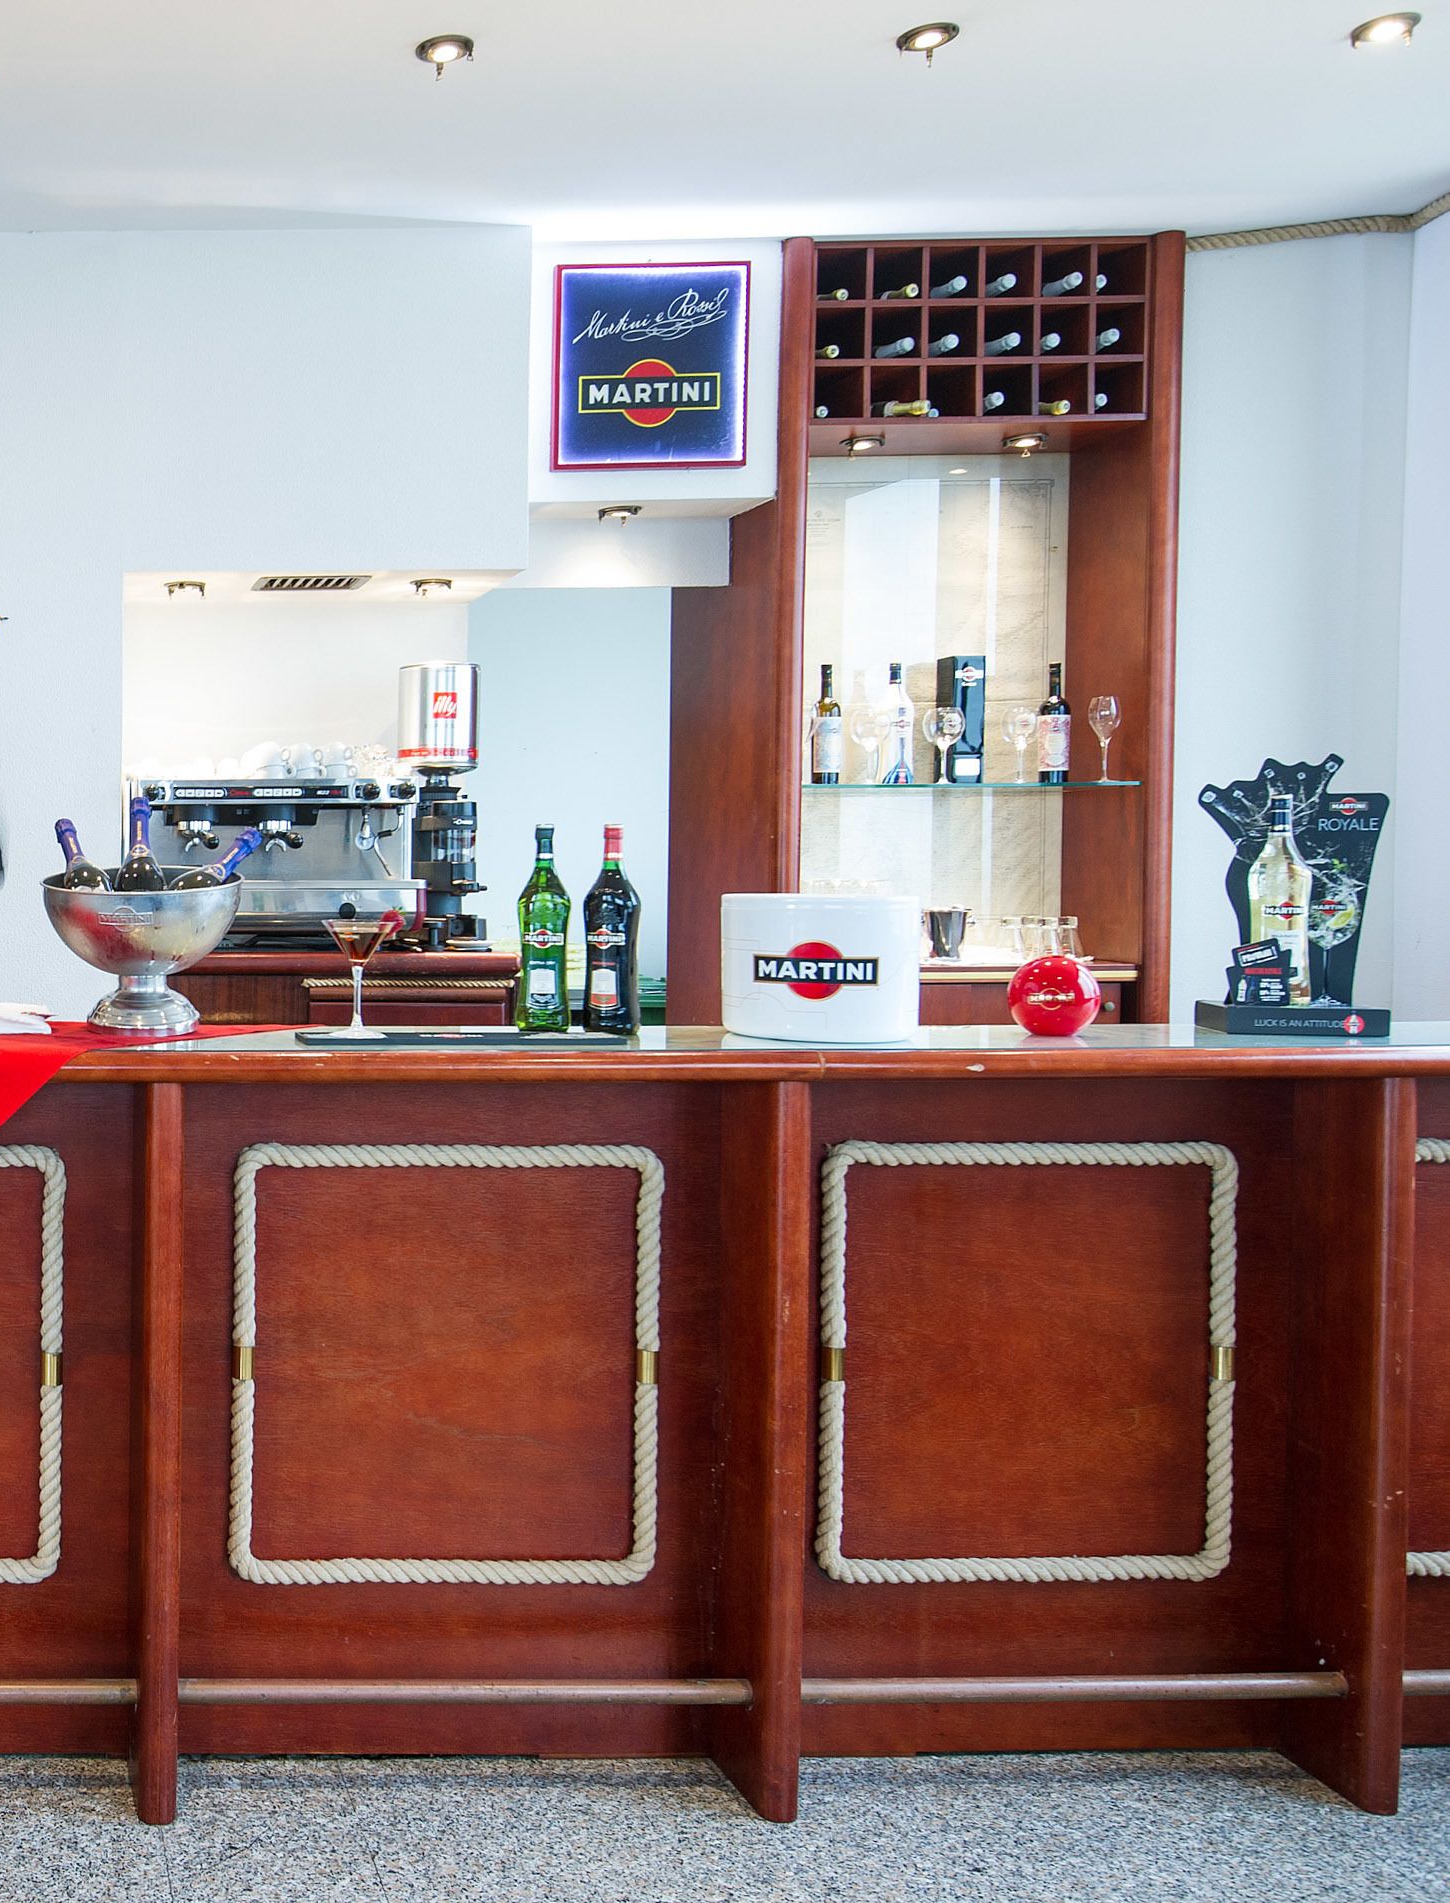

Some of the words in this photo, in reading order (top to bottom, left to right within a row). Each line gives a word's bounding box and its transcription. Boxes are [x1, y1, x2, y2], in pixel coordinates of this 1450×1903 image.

[572, 309, 650, 344] Martini
[655, 312, 665, 323] e
[666, 287, 729, 320] Rossi
[588, 381, 711, 405] MARTINI
[434, 695, 456, 716] illy
[1318, 817, 1380, 831] ROYALE
[757, 959, 874, 981] MARTINI
[1254, 1019, 1278, 1027] LUCK
[1279, 1019, 1287, 1027] IS
[1290, 1019, 1302, 1027] AN
[1303, 1019, 1346, 1028] ATTITUDE
